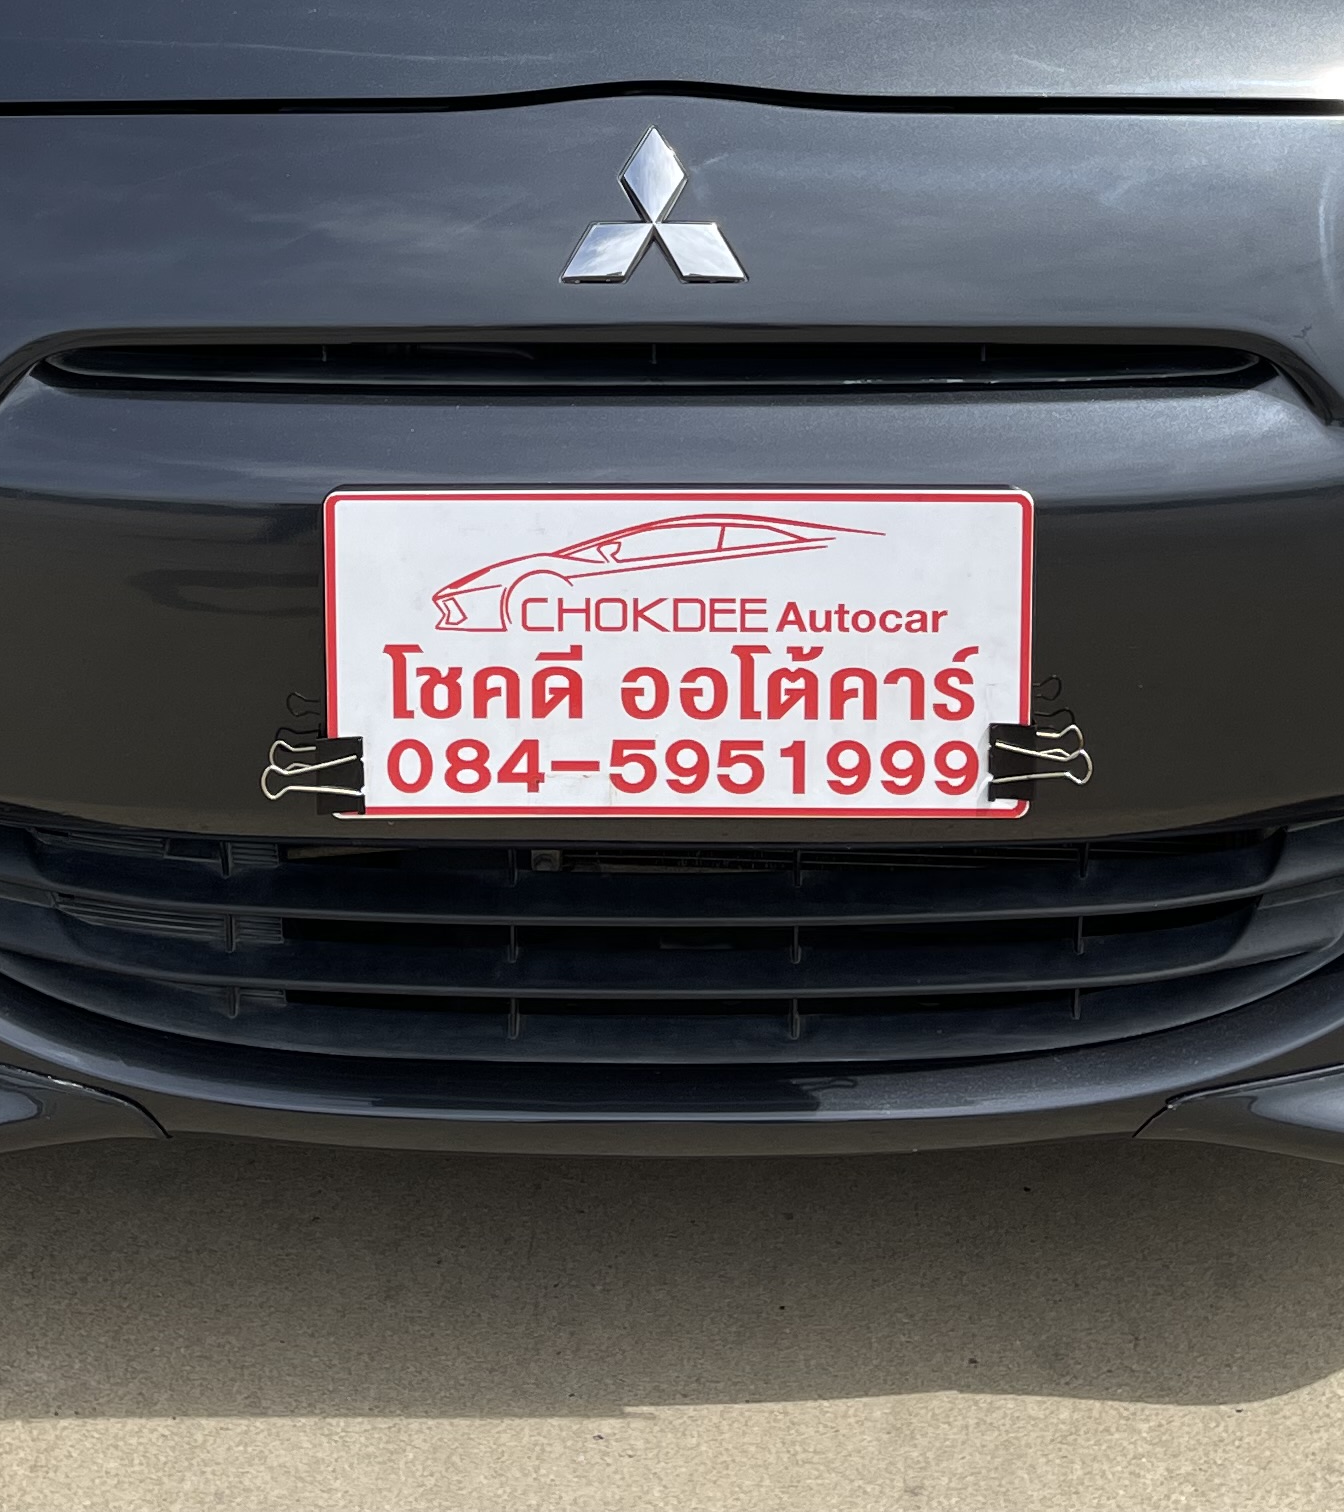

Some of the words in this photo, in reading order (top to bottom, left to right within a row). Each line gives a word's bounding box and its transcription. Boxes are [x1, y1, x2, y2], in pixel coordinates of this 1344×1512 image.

[520, 597, 768, 633] CHOKDEE
[776, 601, 948, 634] Autocar
[383, 643, 584, 720] โชคดี
[620, 644, 980, 722] ออโต้คาร์
[386, 737, 980, 796] 084-5951999
